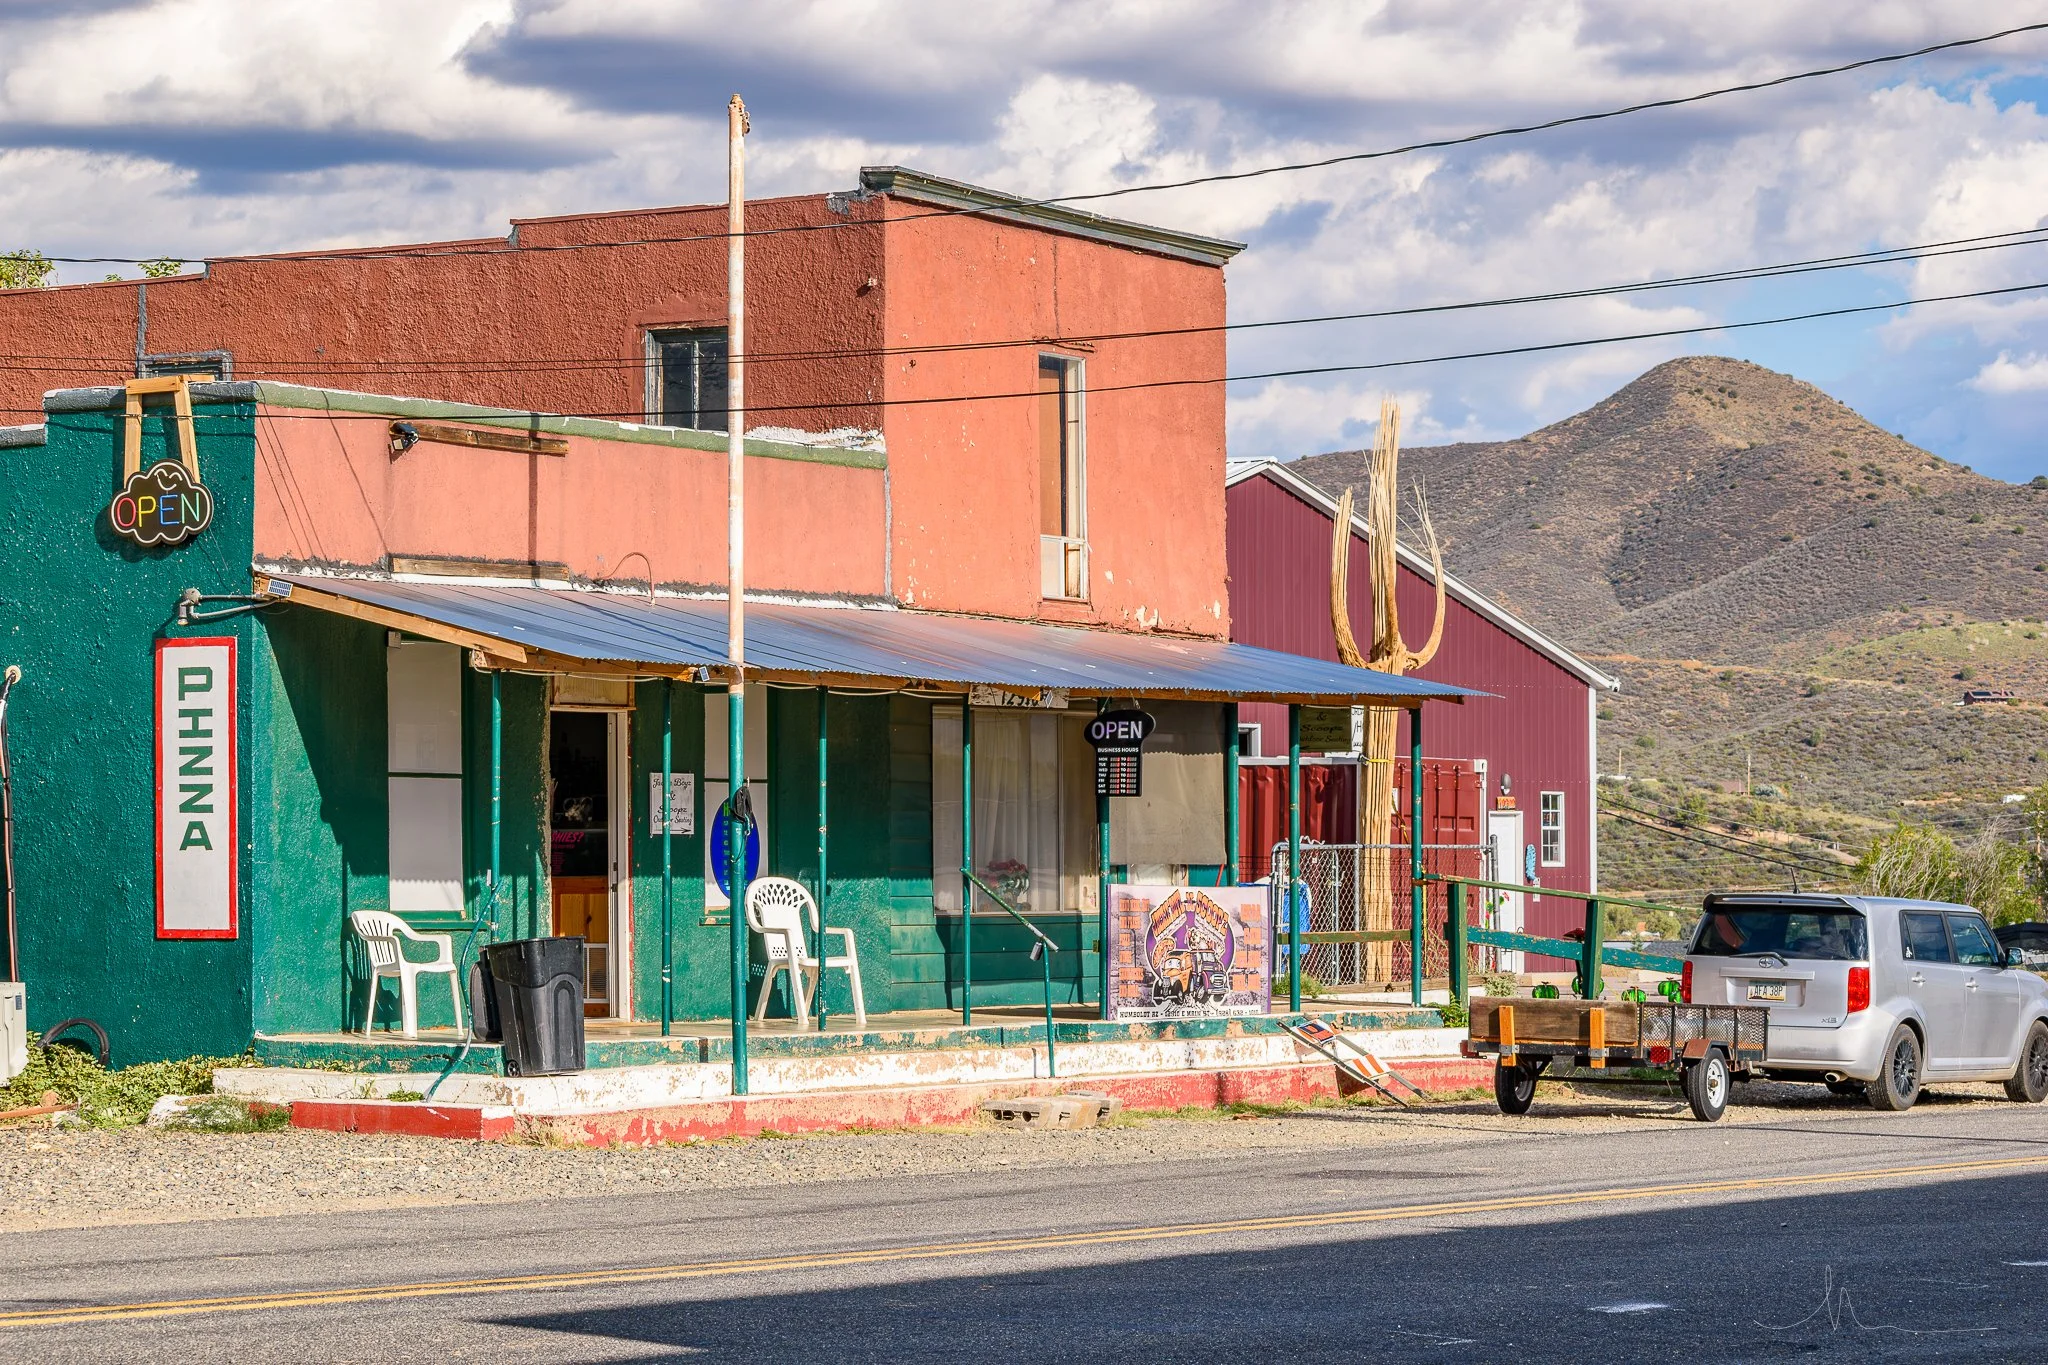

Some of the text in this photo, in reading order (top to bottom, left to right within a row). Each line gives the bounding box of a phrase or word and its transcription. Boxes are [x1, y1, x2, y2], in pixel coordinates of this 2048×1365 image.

[116, 491, 201, 528] OPEN
[1091, 720, 1143, 740] OPEN
[178, 666, 214, 852] PIZZA
